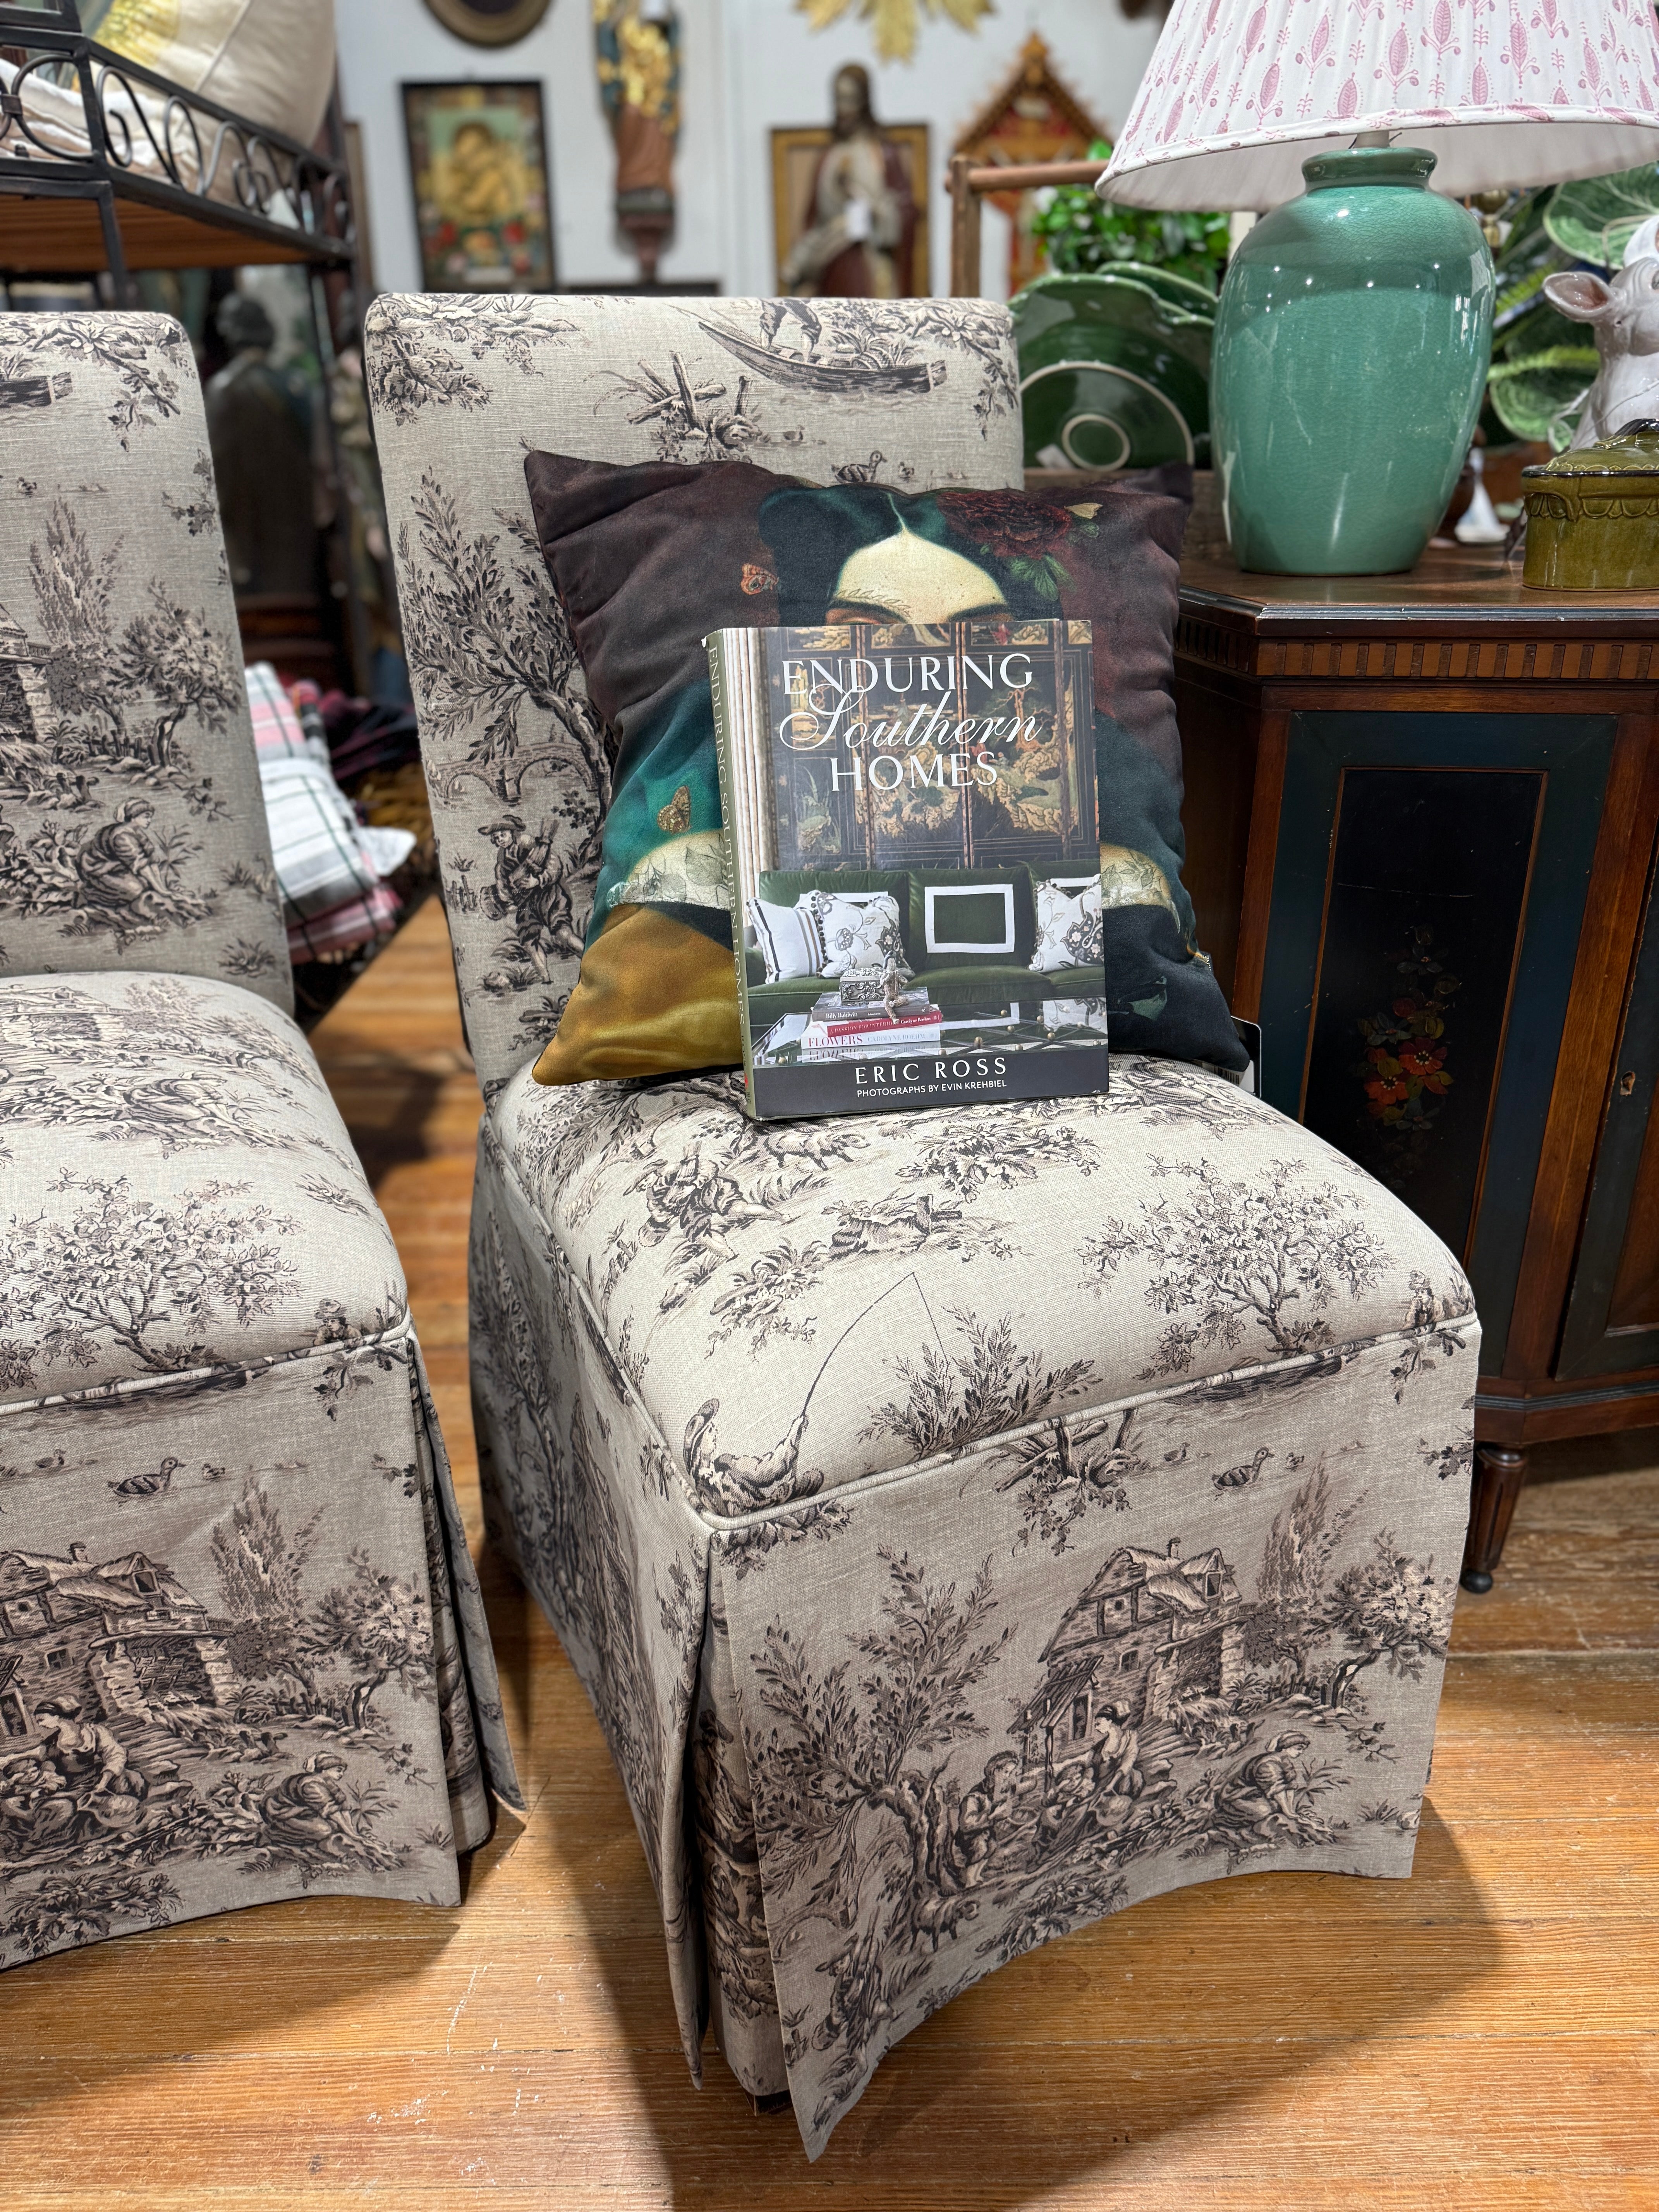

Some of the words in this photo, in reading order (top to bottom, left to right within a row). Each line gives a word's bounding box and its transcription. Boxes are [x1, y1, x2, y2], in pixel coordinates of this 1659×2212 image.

[782, 653, 1032, 695] ENDURING
[779, 683, 1042, 750] Southern
[830, 751, 998, 791] HOMES
[709, 644, 726, 788] ENDURING
[721, 792, 738, 930] SOUTHERN
[733, 939, 744, 1024] HOMES
[809, 1035, 863, 1047] FLOWERS
[855, 1063, 919, 1084] ERIC
[935, 1057, 1006, 1079] ROSS
[857, 1085, 926, 1097] PHOTOGRAPHS
[942, 1083, 962, 1091] EVIN
[965, 1080, 1007, 1090] KREHBIEL
